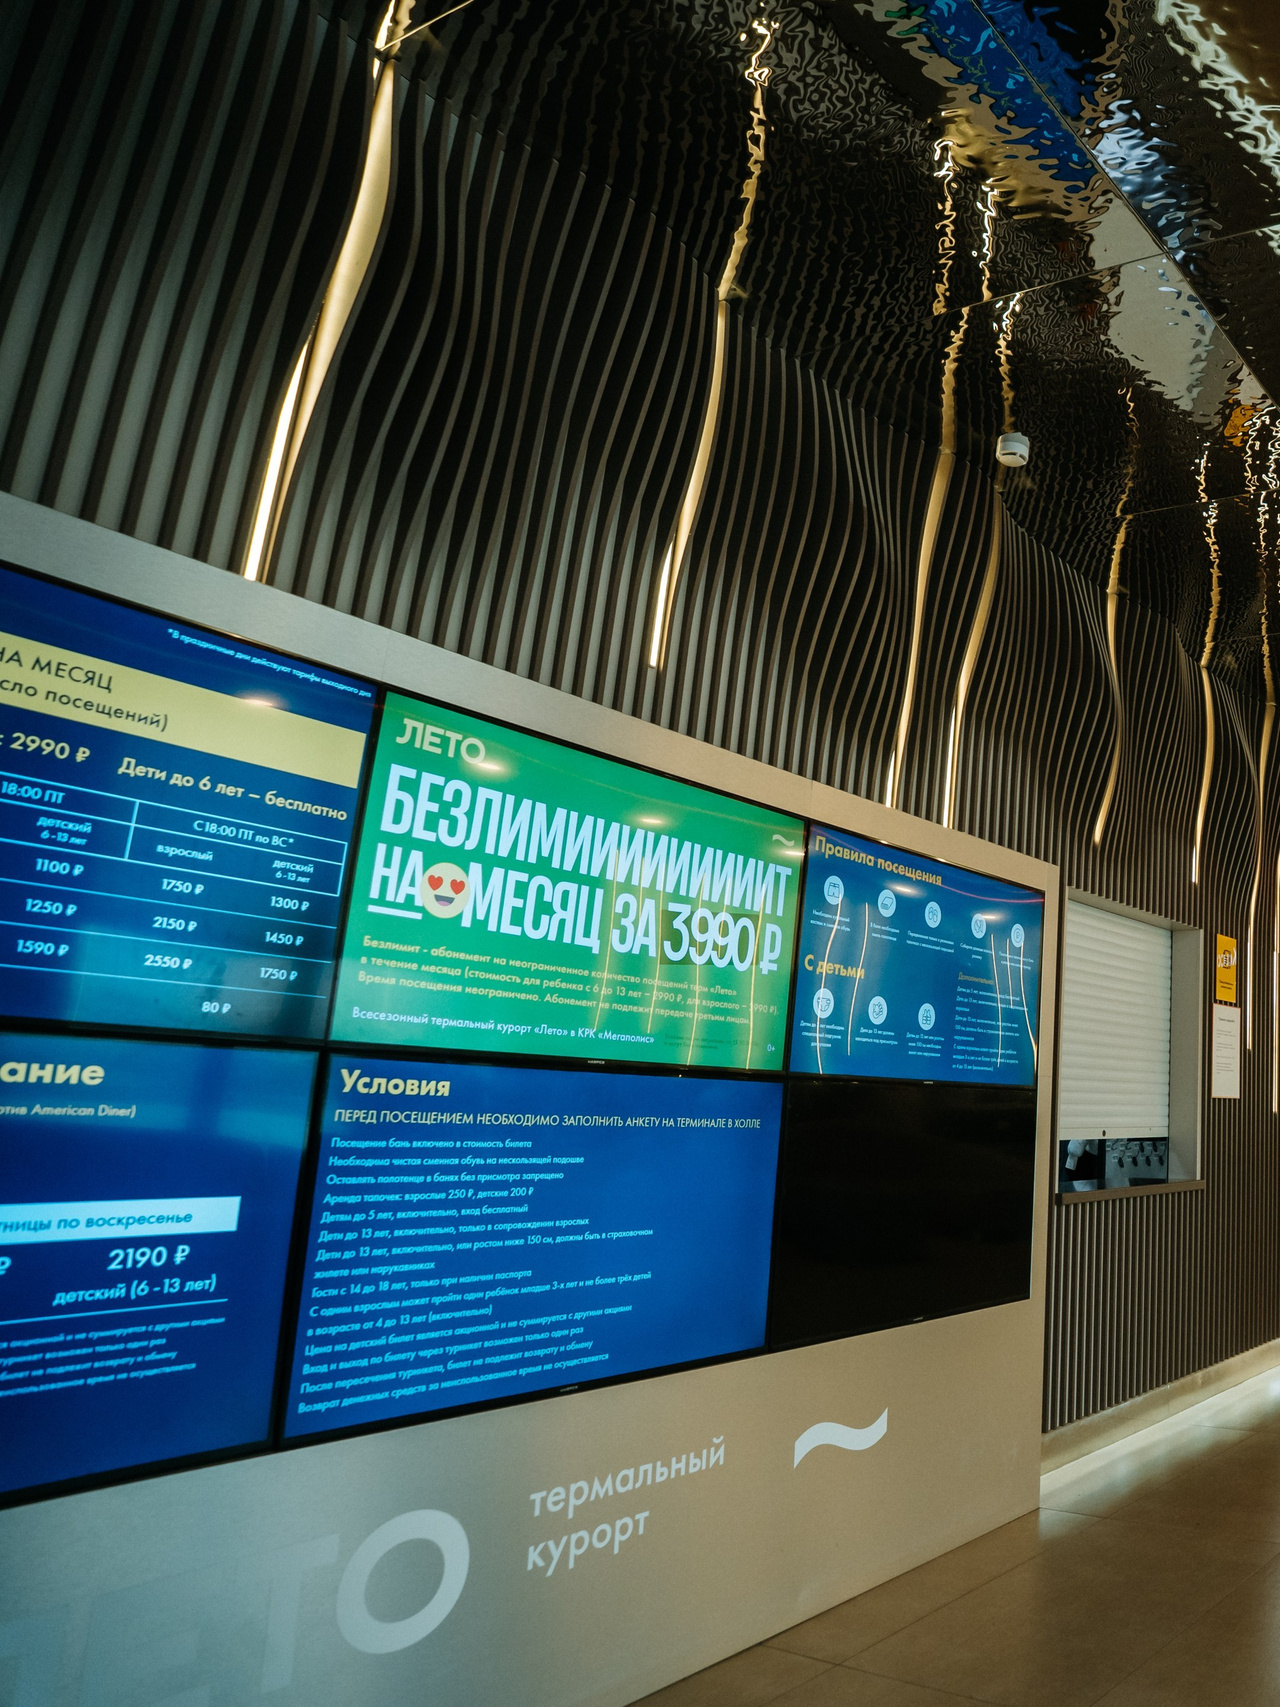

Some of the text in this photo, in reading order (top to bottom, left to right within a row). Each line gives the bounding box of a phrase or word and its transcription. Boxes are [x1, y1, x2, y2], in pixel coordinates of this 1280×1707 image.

[31, 656, 112, 693] МЕСЯЦ
[45, 690, 167, 731] посещений)
[10, 732, 69, 758] 2990
[396, 717, 485, 763] ЛЕТО
[1, 781, 65, 803] 18:00 ПТ
[117, 757, 166, 780] Дети
[169, 773, 193, 786] до
[198, 776, 210, 790] 6
[214, 783, 244, 797] лет
[264, 790, 346, 820] бесплатно
[36, 816, 91, 832] детский
[238, 828, 254, 840] ПТ
[255, 835, 269, 843] по
[156, 844, 212, 860] взрослый
[815, 835, 942, 887] Правила посещения
[36, 858, 69, 874] 1100
[272, 860, 313, 872] детский
[162, 878, 192, 892] 1750
[25, 898, 62, 914] 1250
[270, 896, 298, 909] 1300
[369, 842, 425, 908] НА
[461, 862, 604, 954] МЕСЯЦ
[611, 893, 657, 958] ЗА
[663, 901, 756, 973] 3990
[152, 916, 185, 930] 2150
[17, 939, 54, 954] 1590
[265, 931, 293, 944] 1450
[144, 954, 180, 968] 2550
[363, 935, 420, 952] Безлимит
[430, 946, 490, 962] абонемент
[493, 957, 506, 965] на
[508, 959, 588, 976] неограниченное
[591, 968, 640, 983] количество
[642, 974, 687, 989] посещений
[710, 985, 736, 995] «Лето»
[804, 953, 866, 980] С детьми
[260, 967, 286, 979] 1750
[371, 957, 418, 970] течение
[420, 964, 461, 975] месяца
[464, 966, 520, 982] (стоимость
[522, 977, 540, 985] для
[542, 978, 583, 990] ребенка
[592, 984, 598, 992] 6
[616, 986, 625, 995] 13
[702, 1000, 739, 1009] взрослого
[358, 970, 395, 984] Время
[399, 979, 462, 992] посещения
[464, 986, 540, 1001] неограничено.
[543, 993, 596, 1006] Абонемент
[655, 1008, 692, 1017] передаче
[201, 1001, 219, 1012] 80
[352, 1006, 428, 1023] Всесезонный
[431, 1017, 494, 1029] термальный
[496, 1023, 531, 1035] курорт
[534, 1024, 567, 1035] «Лето»
[577, 1026, 596, 1038] КРК
[598, 1030, 654, 1042] «Мегаполис»
[767, 1043, 776, 1052] 0+
[340, 1068, 451, 1097] Условия
[30, 1104, 94, 1115] American
[97, 1104, 135, 1118] Diner)
[334, 1109, 760, 1127] ПЕРЕД ПОСЕЩЕНИЕМ НЕОБХОДИМО ЗАПОЛНИТЬ АНКЕТУ НА ТЕРМИНАЛЕ В ХОЛЛЕ
[330, 1137, 386, 1148] Посещение
[388, 1137, 410, 1147] бань
[504, 1138, 531, 1147] билета
[322, 1193, 361, 1205] Аренда
[404, 1192, 446, 1202] взрослые
[448, 1188, 466, 1198] 250
[476, 1190, 508, 1198] детские
[510, 1187, 526, 1196] 200
[56, 1218, 80, 1229] по
[85, 1213, 192, 1229] воскресенье
[107, 1246, 167, 1269] 2190
[52, 1283, 126, 1306] детский
[183, 1273, 216, 1292] лет)
[529, 1435, 726, 1517] термальный
[526, 1506, 650, 1576] курорт
